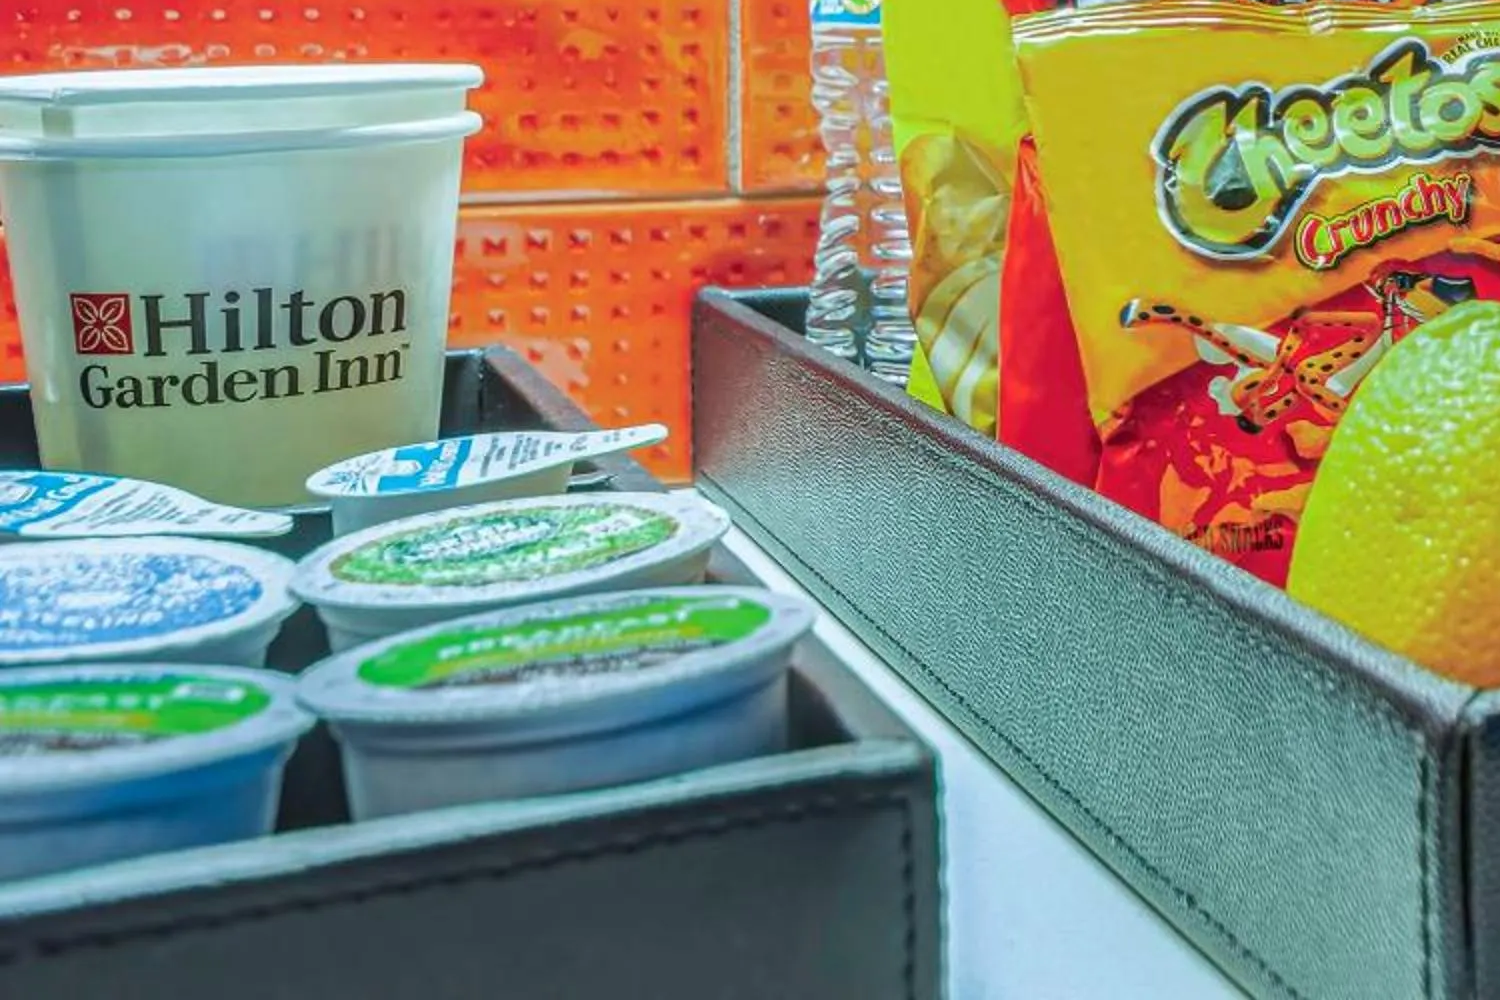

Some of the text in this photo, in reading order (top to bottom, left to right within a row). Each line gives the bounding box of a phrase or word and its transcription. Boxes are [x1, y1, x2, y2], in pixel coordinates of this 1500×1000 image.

[1301, 174, 1471, 266] Crunchy
[139, 287, 407, 358] Hilton
[79, 346, 404, 410] Garden Inn
